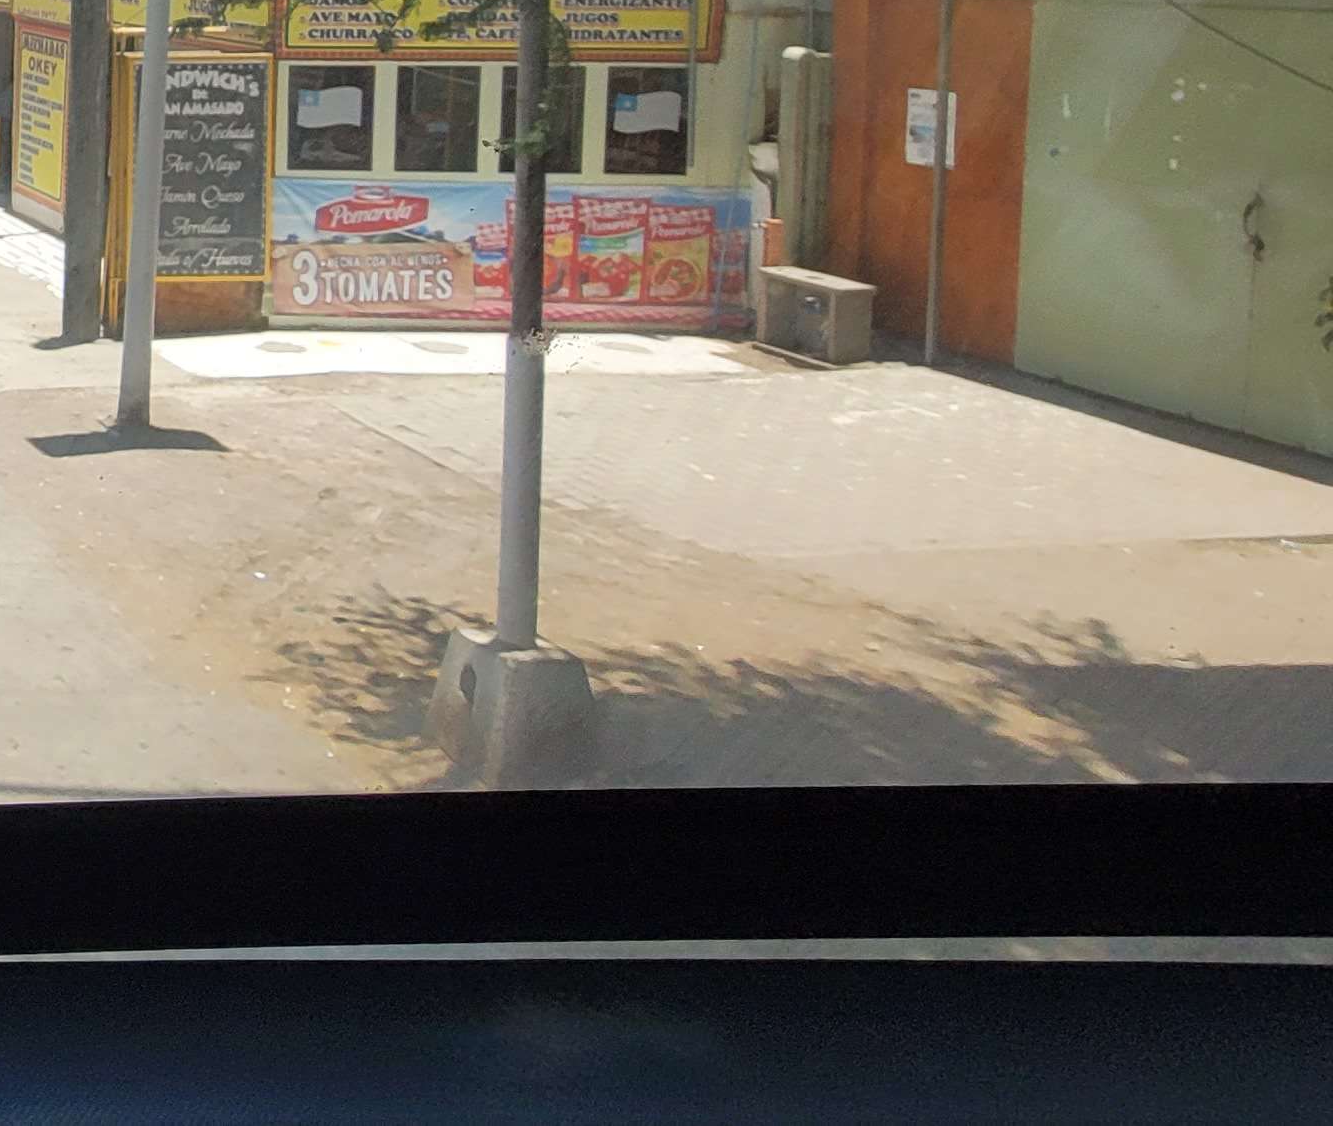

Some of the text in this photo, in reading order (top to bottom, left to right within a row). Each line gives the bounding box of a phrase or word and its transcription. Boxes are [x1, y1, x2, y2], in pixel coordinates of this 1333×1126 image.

[309, 12, 342, 22] AVE
[562, 12, 619, 22] JUGOS
[28, 57, 58, 76] OKEY
[328, 199, 416, 228] Pomarola
[292, 250, 319, 306] 3
[321, 269, 453, 303] TOMATES
